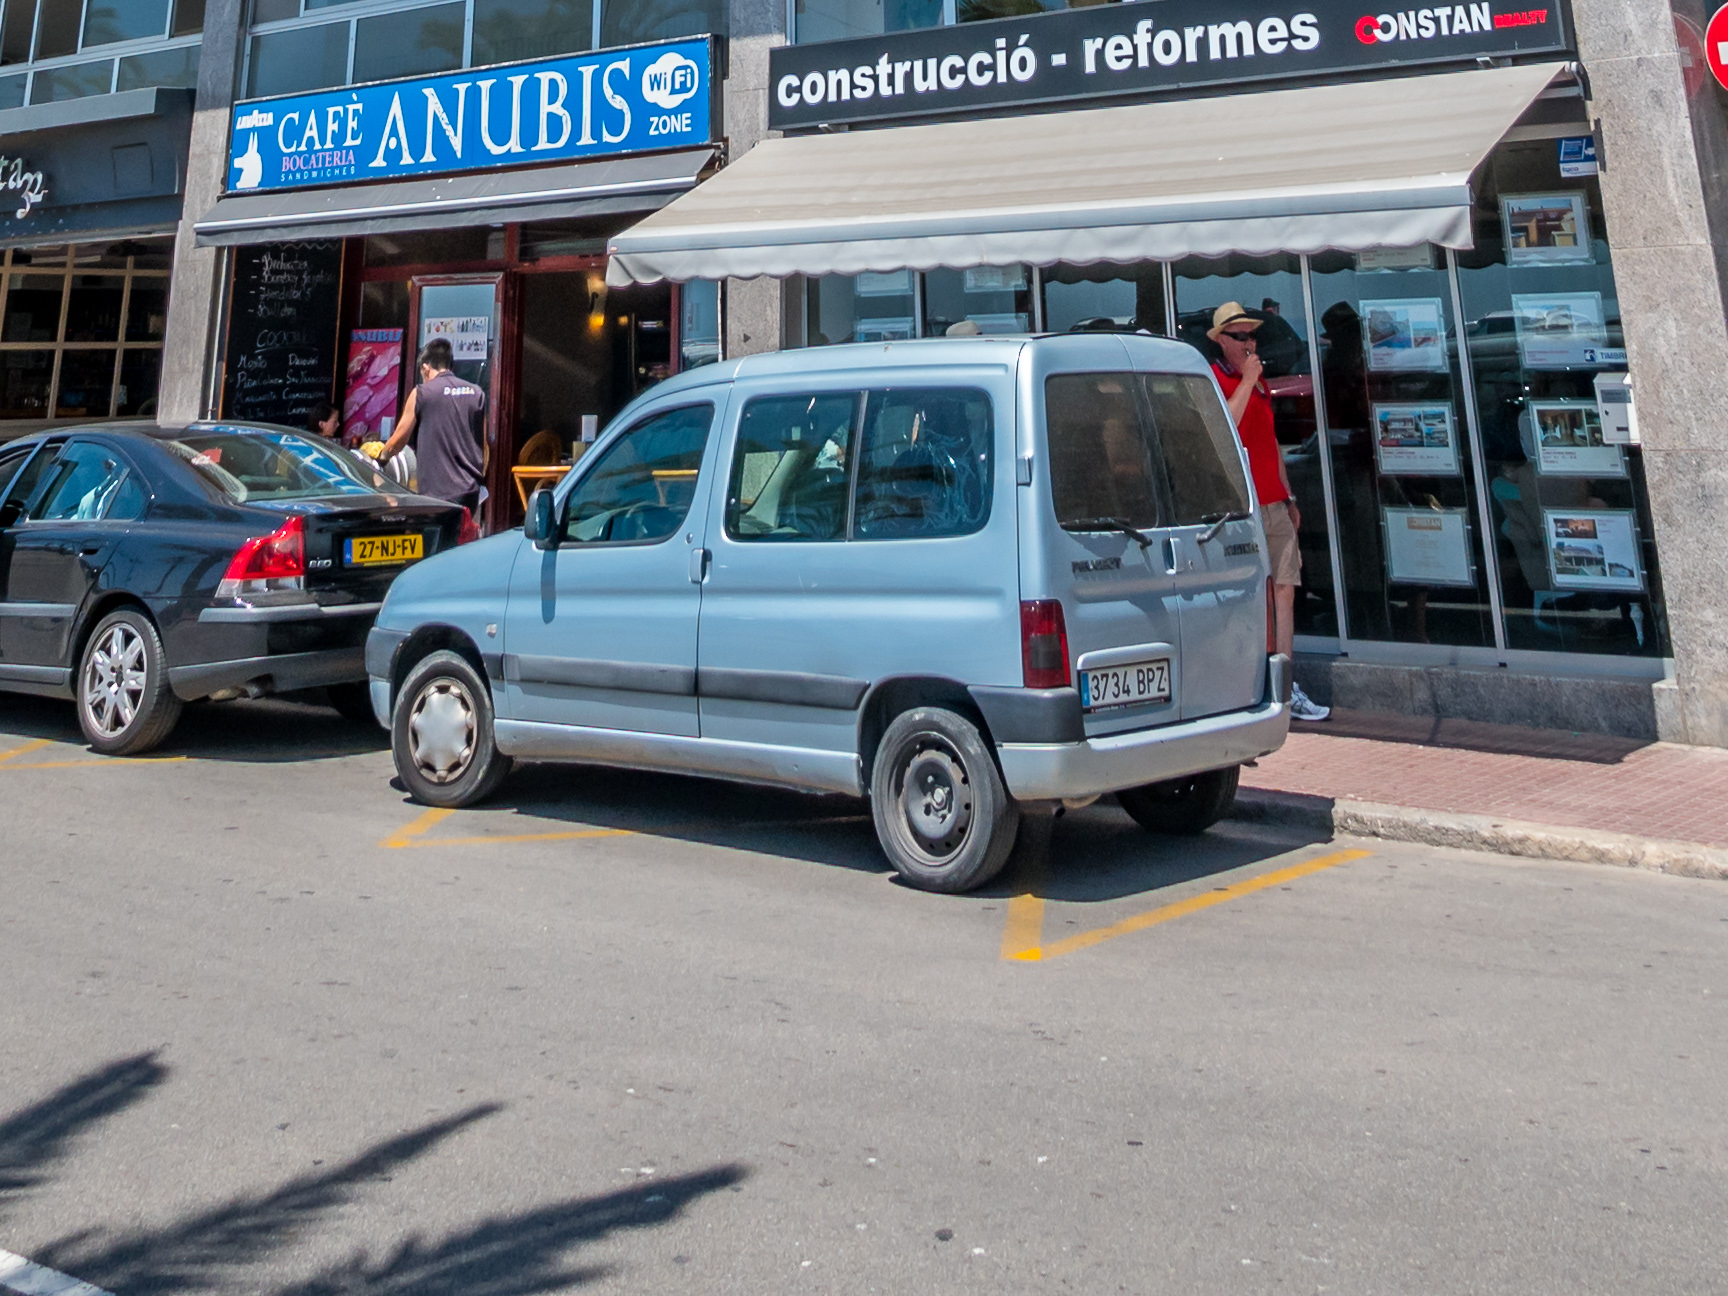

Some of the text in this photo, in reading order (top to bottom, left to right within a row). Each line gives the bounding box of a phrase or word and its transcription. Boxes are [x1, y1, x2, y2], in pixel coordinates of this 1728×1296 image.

[1355, 2, 1547, 44] CONSTAN REALTY
[777, 34, 1037, 107] construcció
[1083, 12, 1321, 74] reformes
[369, 57, 632, 167] ANUBIS
[649, 113, 692, 136] ZONE
[280, 166, 356, 182] SANDWICHES
[281, 149, 355, 173] BOCATERIA
[359, 538, 417, 559] 27-NJ-FV
[1091, 666, 1166, 702] 3734 BPZ
